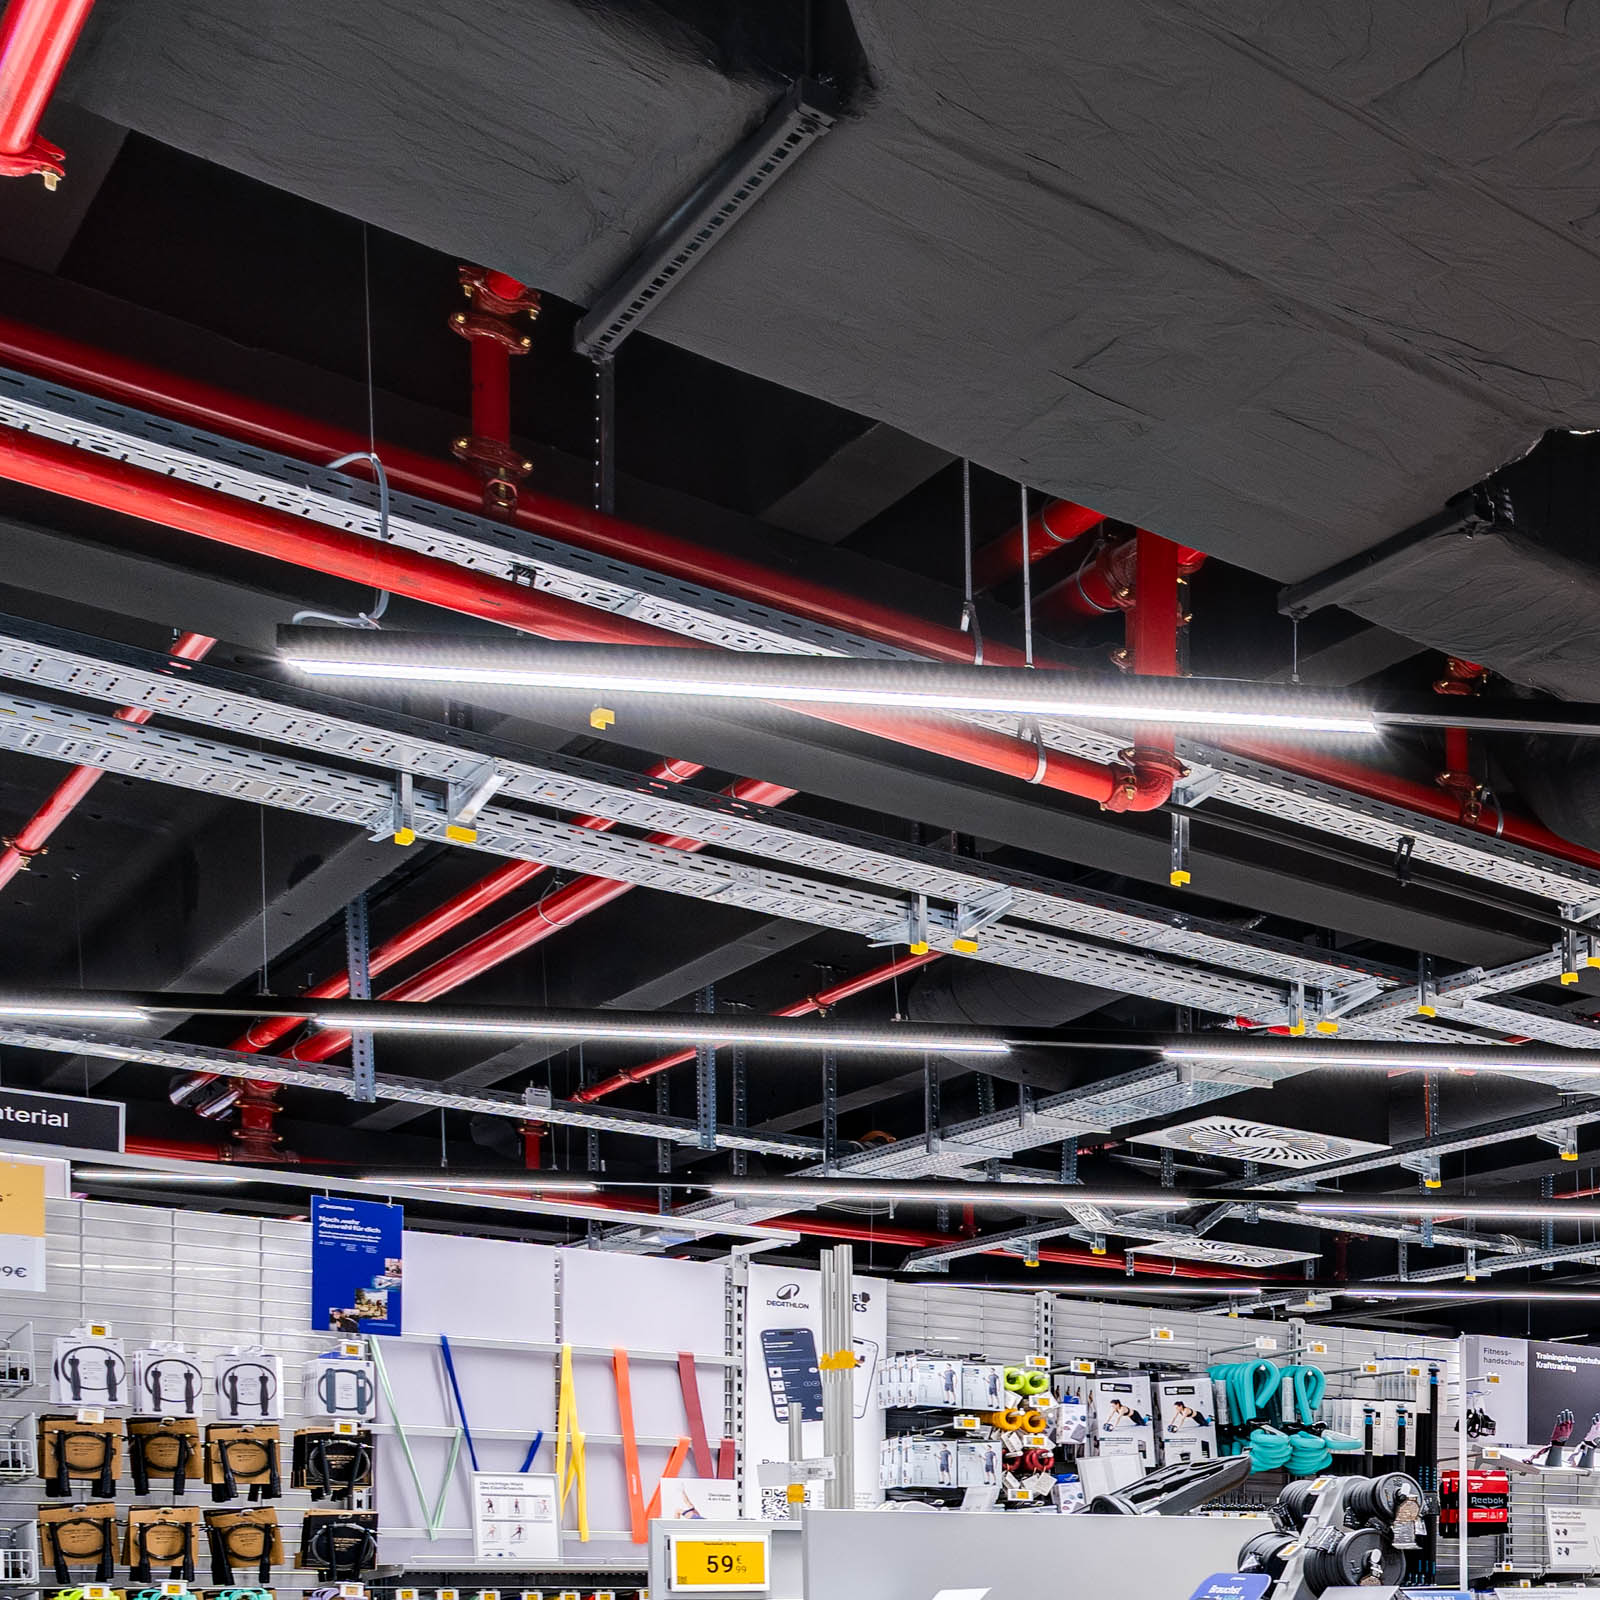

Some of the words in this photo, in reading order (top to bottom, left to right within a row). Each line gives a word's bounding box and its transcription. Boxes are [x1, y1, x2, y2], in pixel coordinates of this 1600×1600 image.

[0, 1106, 69, 1128] terial
[0, 1266, 27, 1278] 9€
[766, 1299, 810, 1310] DECATHLON
[1483, 1347, 1512, 1356] Fitness-
[1483, 1357, 1525, 1367] handschuhe
[1536, 1361, 1577, 1373] Krafttraining
[1471, 1496, 1504, 1504] Reebok
[706, 1555, 733, 1573] 59
